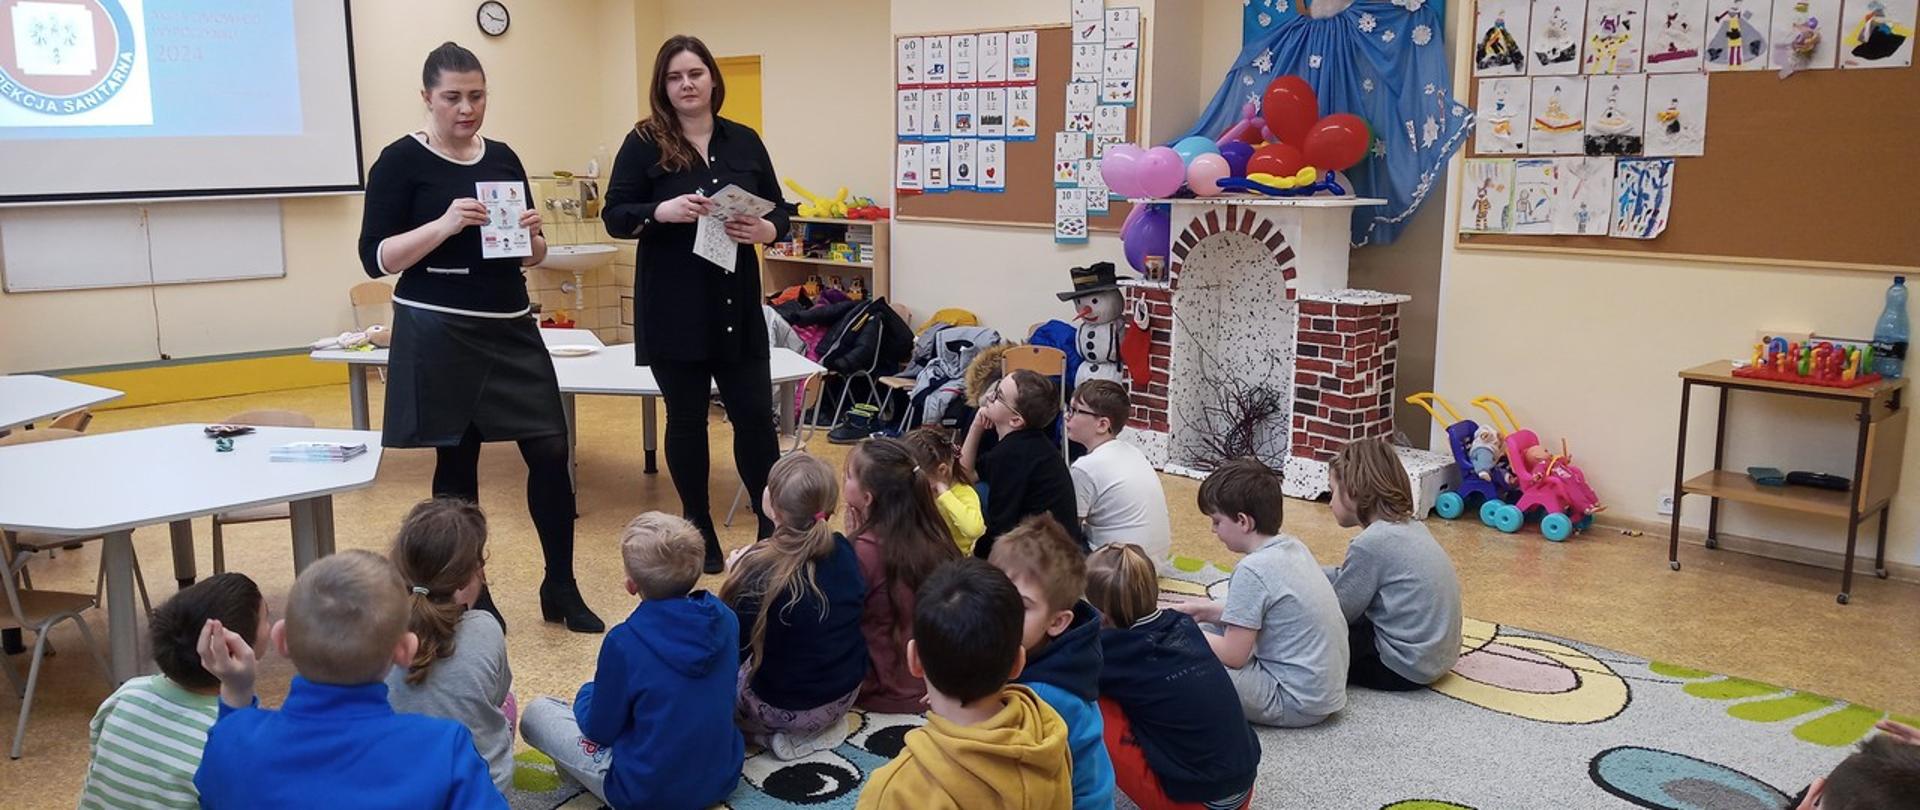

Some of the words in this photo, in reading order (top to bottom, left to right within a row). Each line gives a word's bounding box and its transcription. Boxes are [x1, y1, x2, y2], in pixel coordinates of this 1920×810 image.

[1114, 11, 1119, 21] 2
[1080, 46, 1086, 56] 3
[1112, 52, 1117, 61] 4
[64, 51, 134, 113] SANITARNA
[1015, 90, 1028, 100] kK
[1074, 85, 1079, 95] 5
[1102, 108, 1107, 117] 6
[1063, 135, 1069, 144] 7
[1085, 162, 1092, 171] 9
[1063, 190, 1072, 201] 10
